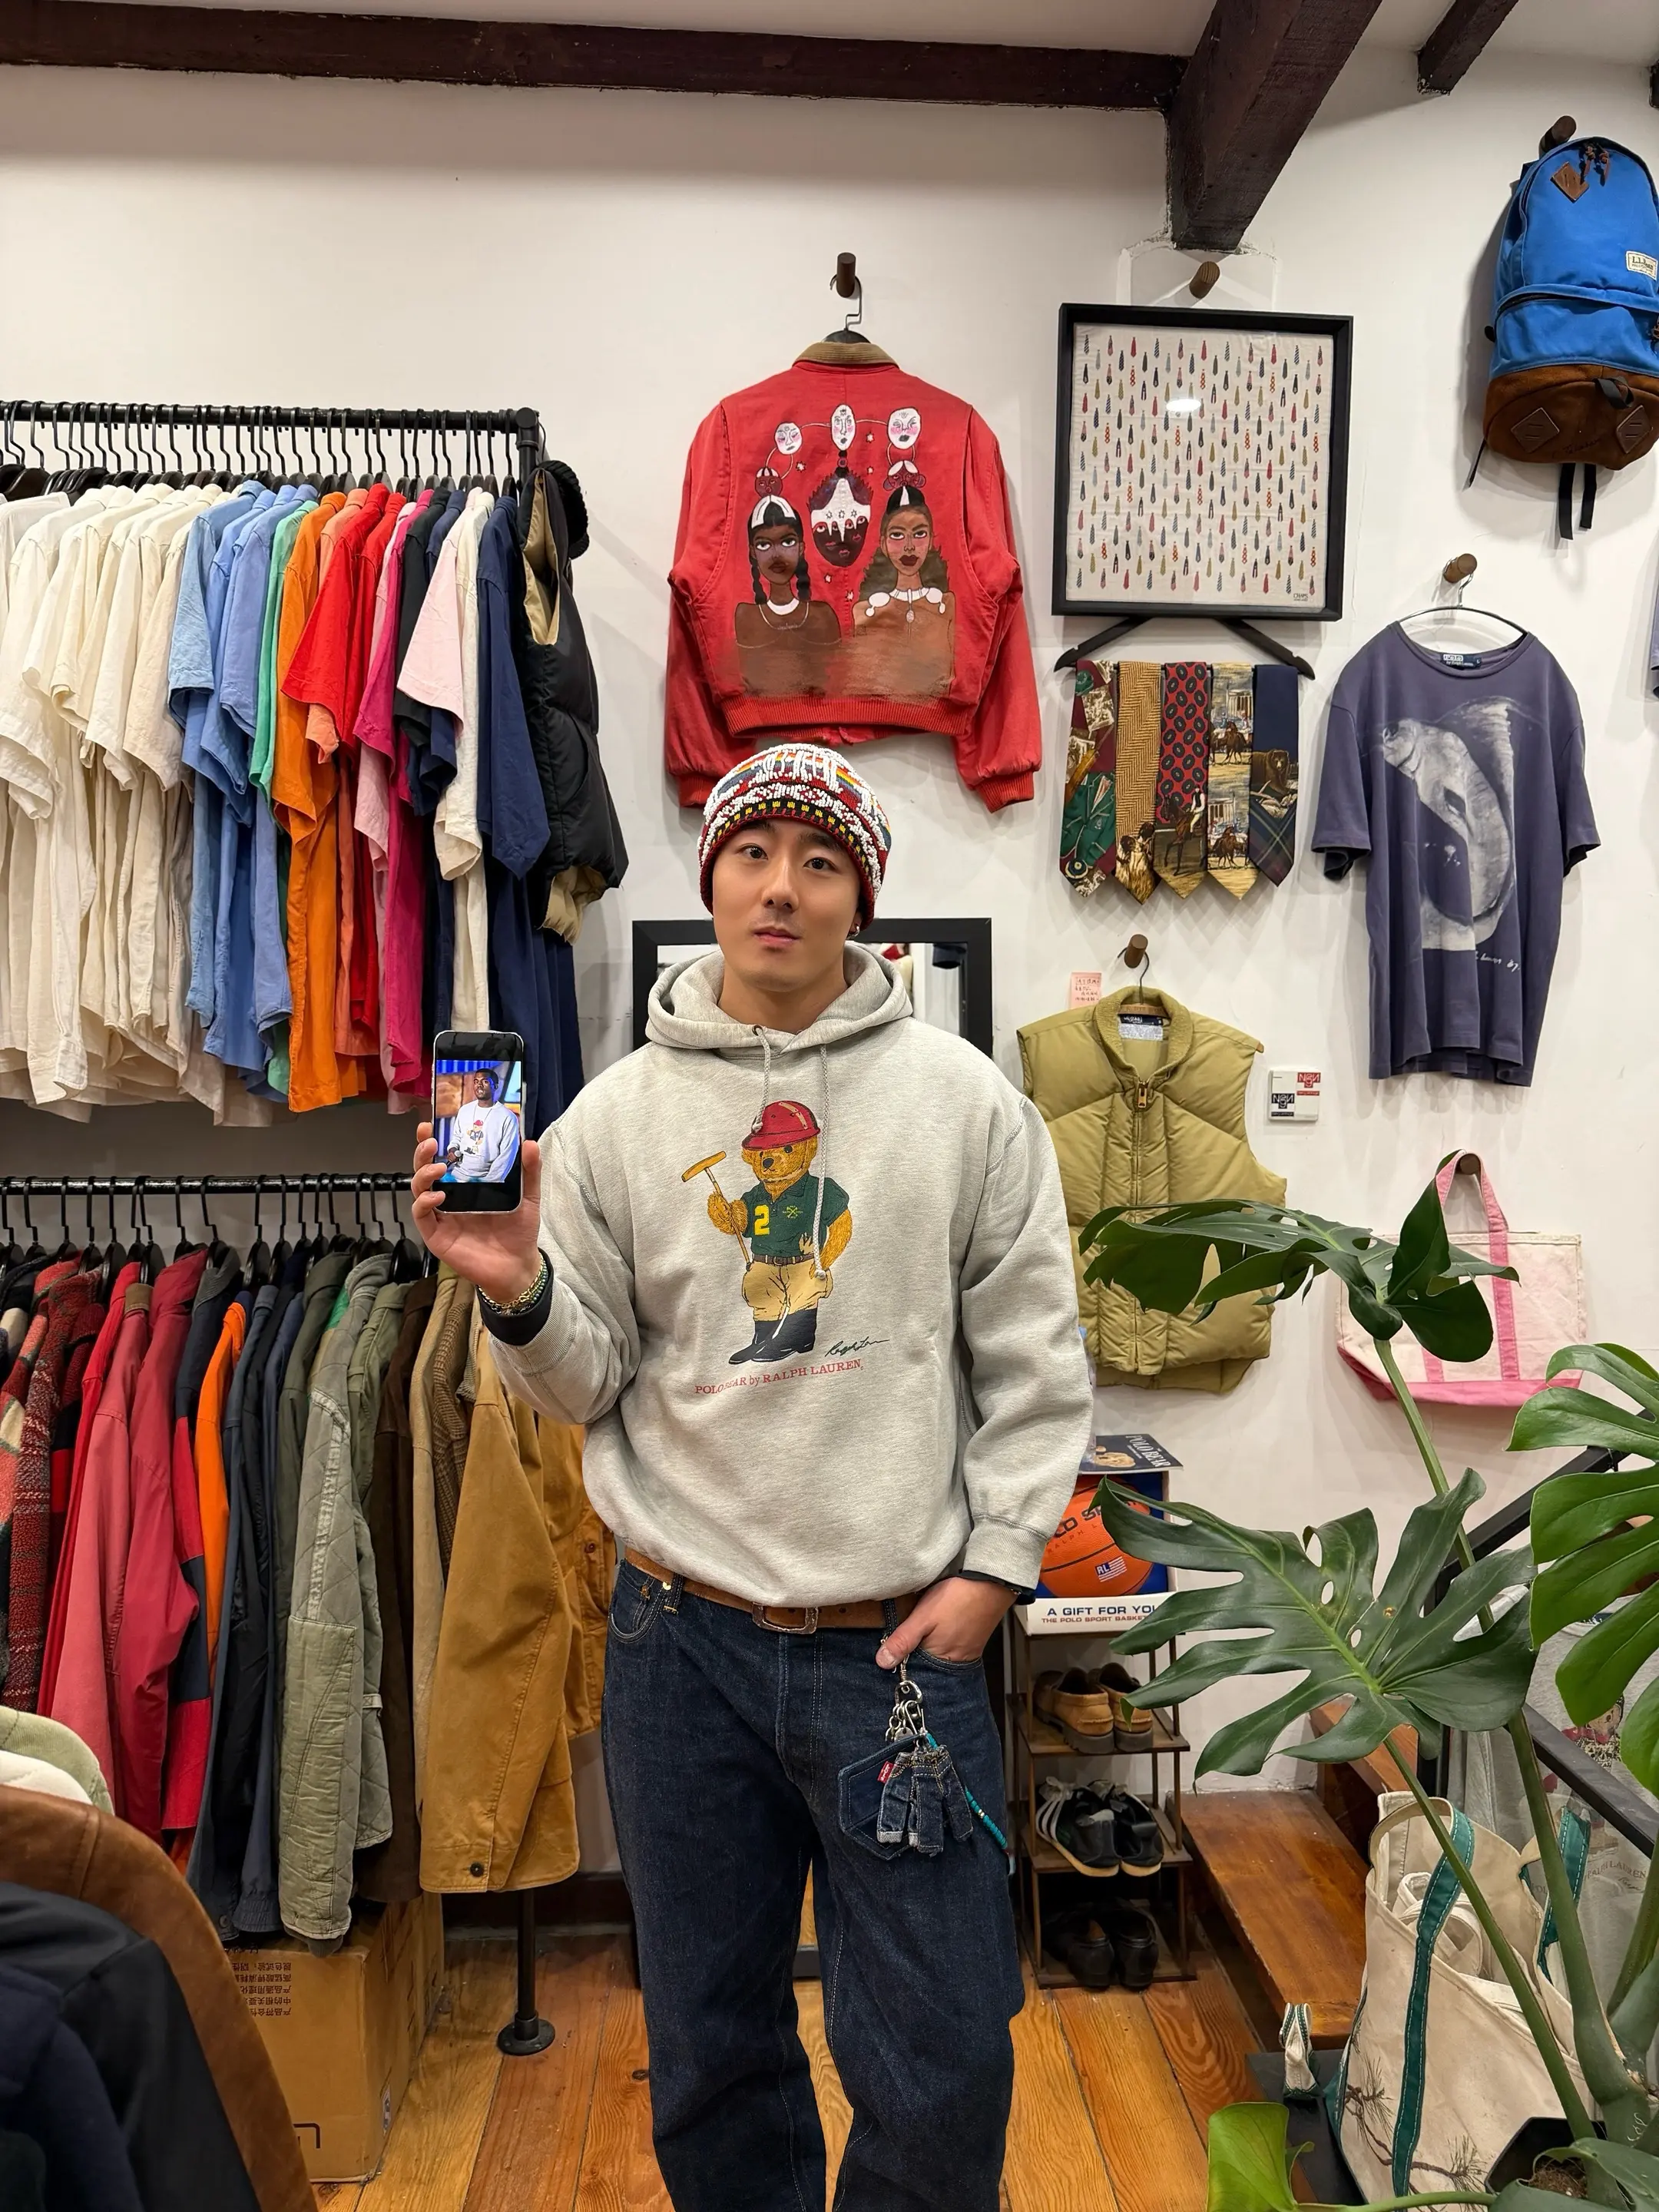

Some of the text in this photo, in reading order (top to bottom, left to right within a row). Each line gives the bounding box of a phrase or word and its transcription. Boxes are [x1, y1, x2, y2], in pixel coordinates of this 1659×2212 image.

[754, 1204, 770, 1236] 2
[749, 1375, 760, 1387] by
[763, 1367, 808, 1383] RALPH
[810, 1358, 862, 1375] LAUREN
[1125, 1435, 1154, 1452] POLO
[1096, 1565, 1111, 1575] RL
[1047, 1608, 1058, 1616] A
[1062, 1607, 1093, 1616] GIFT
[1098, 1605, 1127, 1615] FOR
